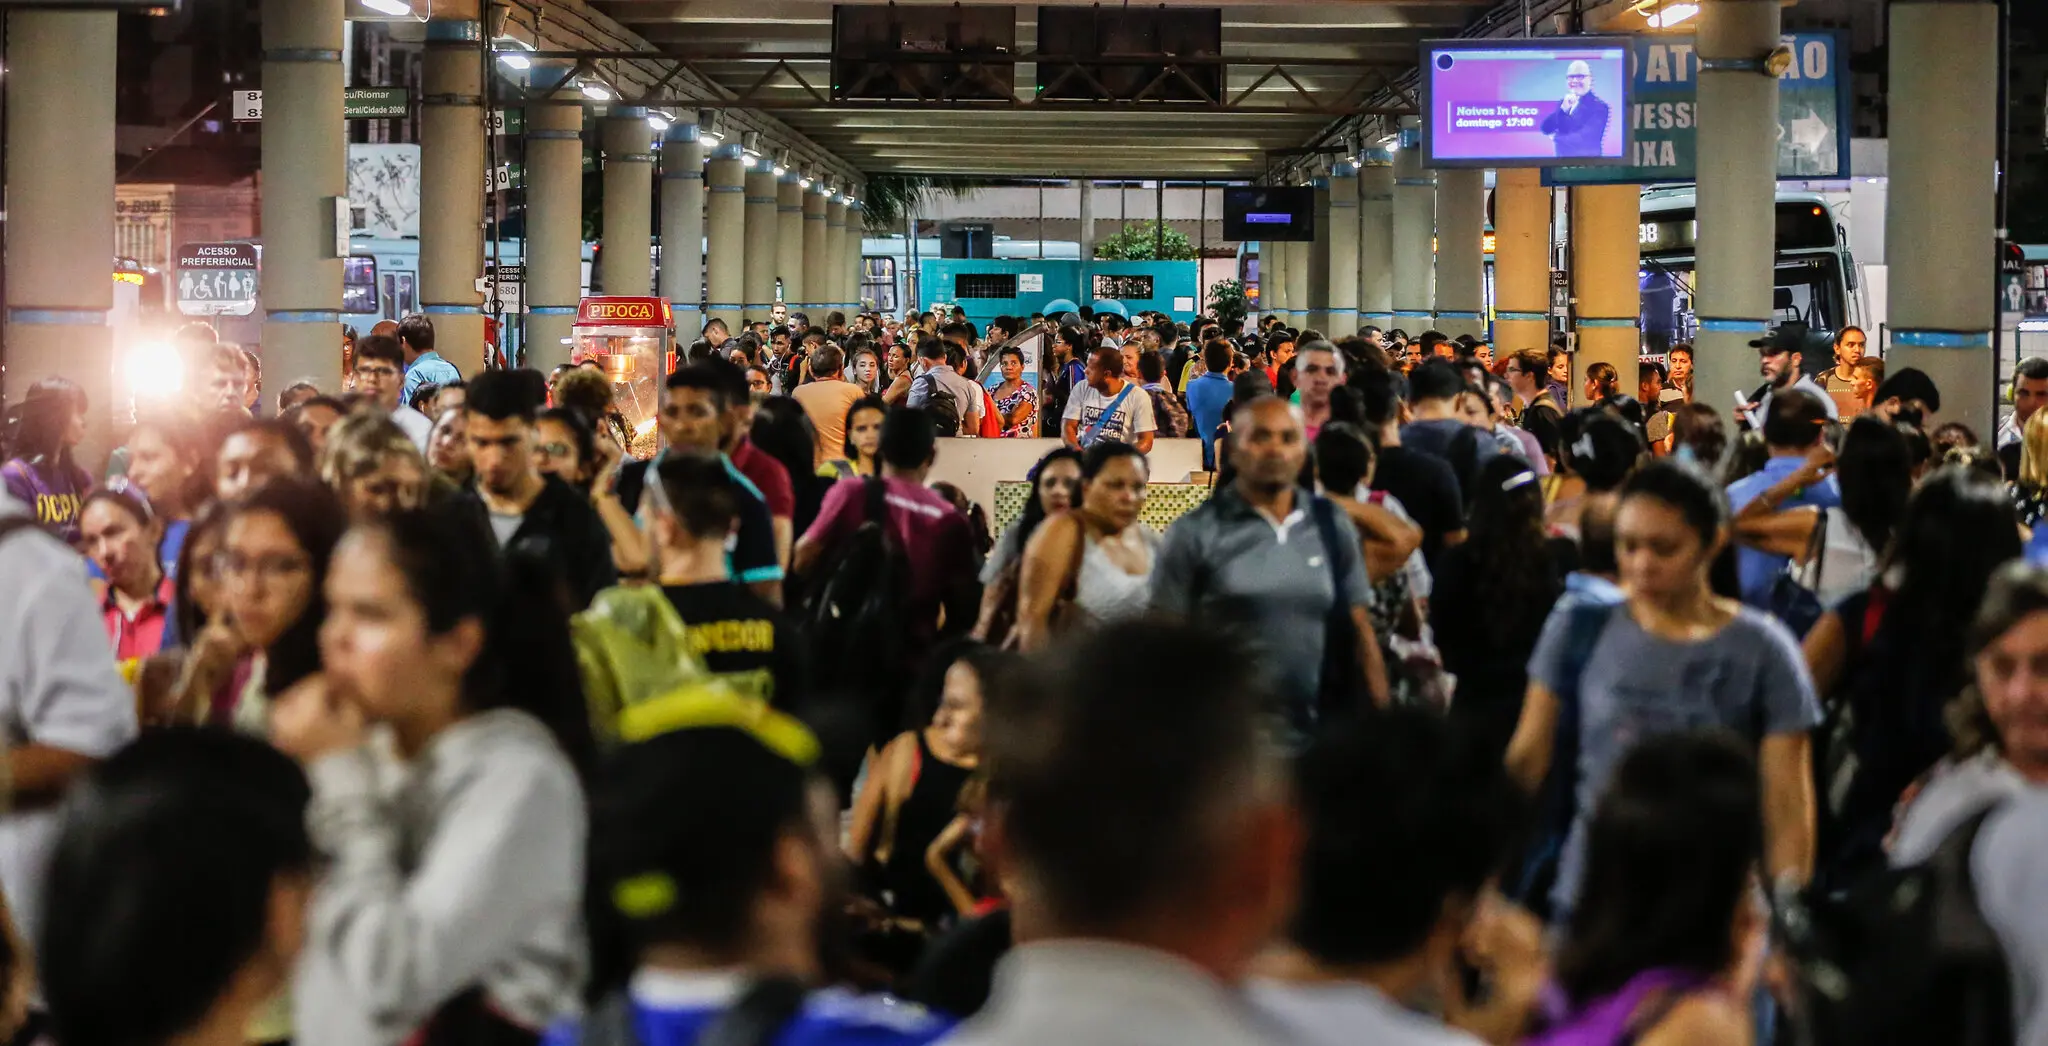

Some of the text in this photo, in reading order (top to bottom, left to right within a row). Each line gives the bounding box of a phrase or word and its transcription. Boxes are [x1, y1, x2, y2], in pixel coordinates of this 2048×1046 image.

[389, 106, 406, 114] 2000
[1456, 106, 1538, 116] Noivos In Foco
[1456, 117, 1534, 128] domingo 17:00
[197, 247, 237, 256] ACESSO
[181, 258, 253, 266] PREFERENCIAL
[590, 305, 651, 317] PIPOCA
